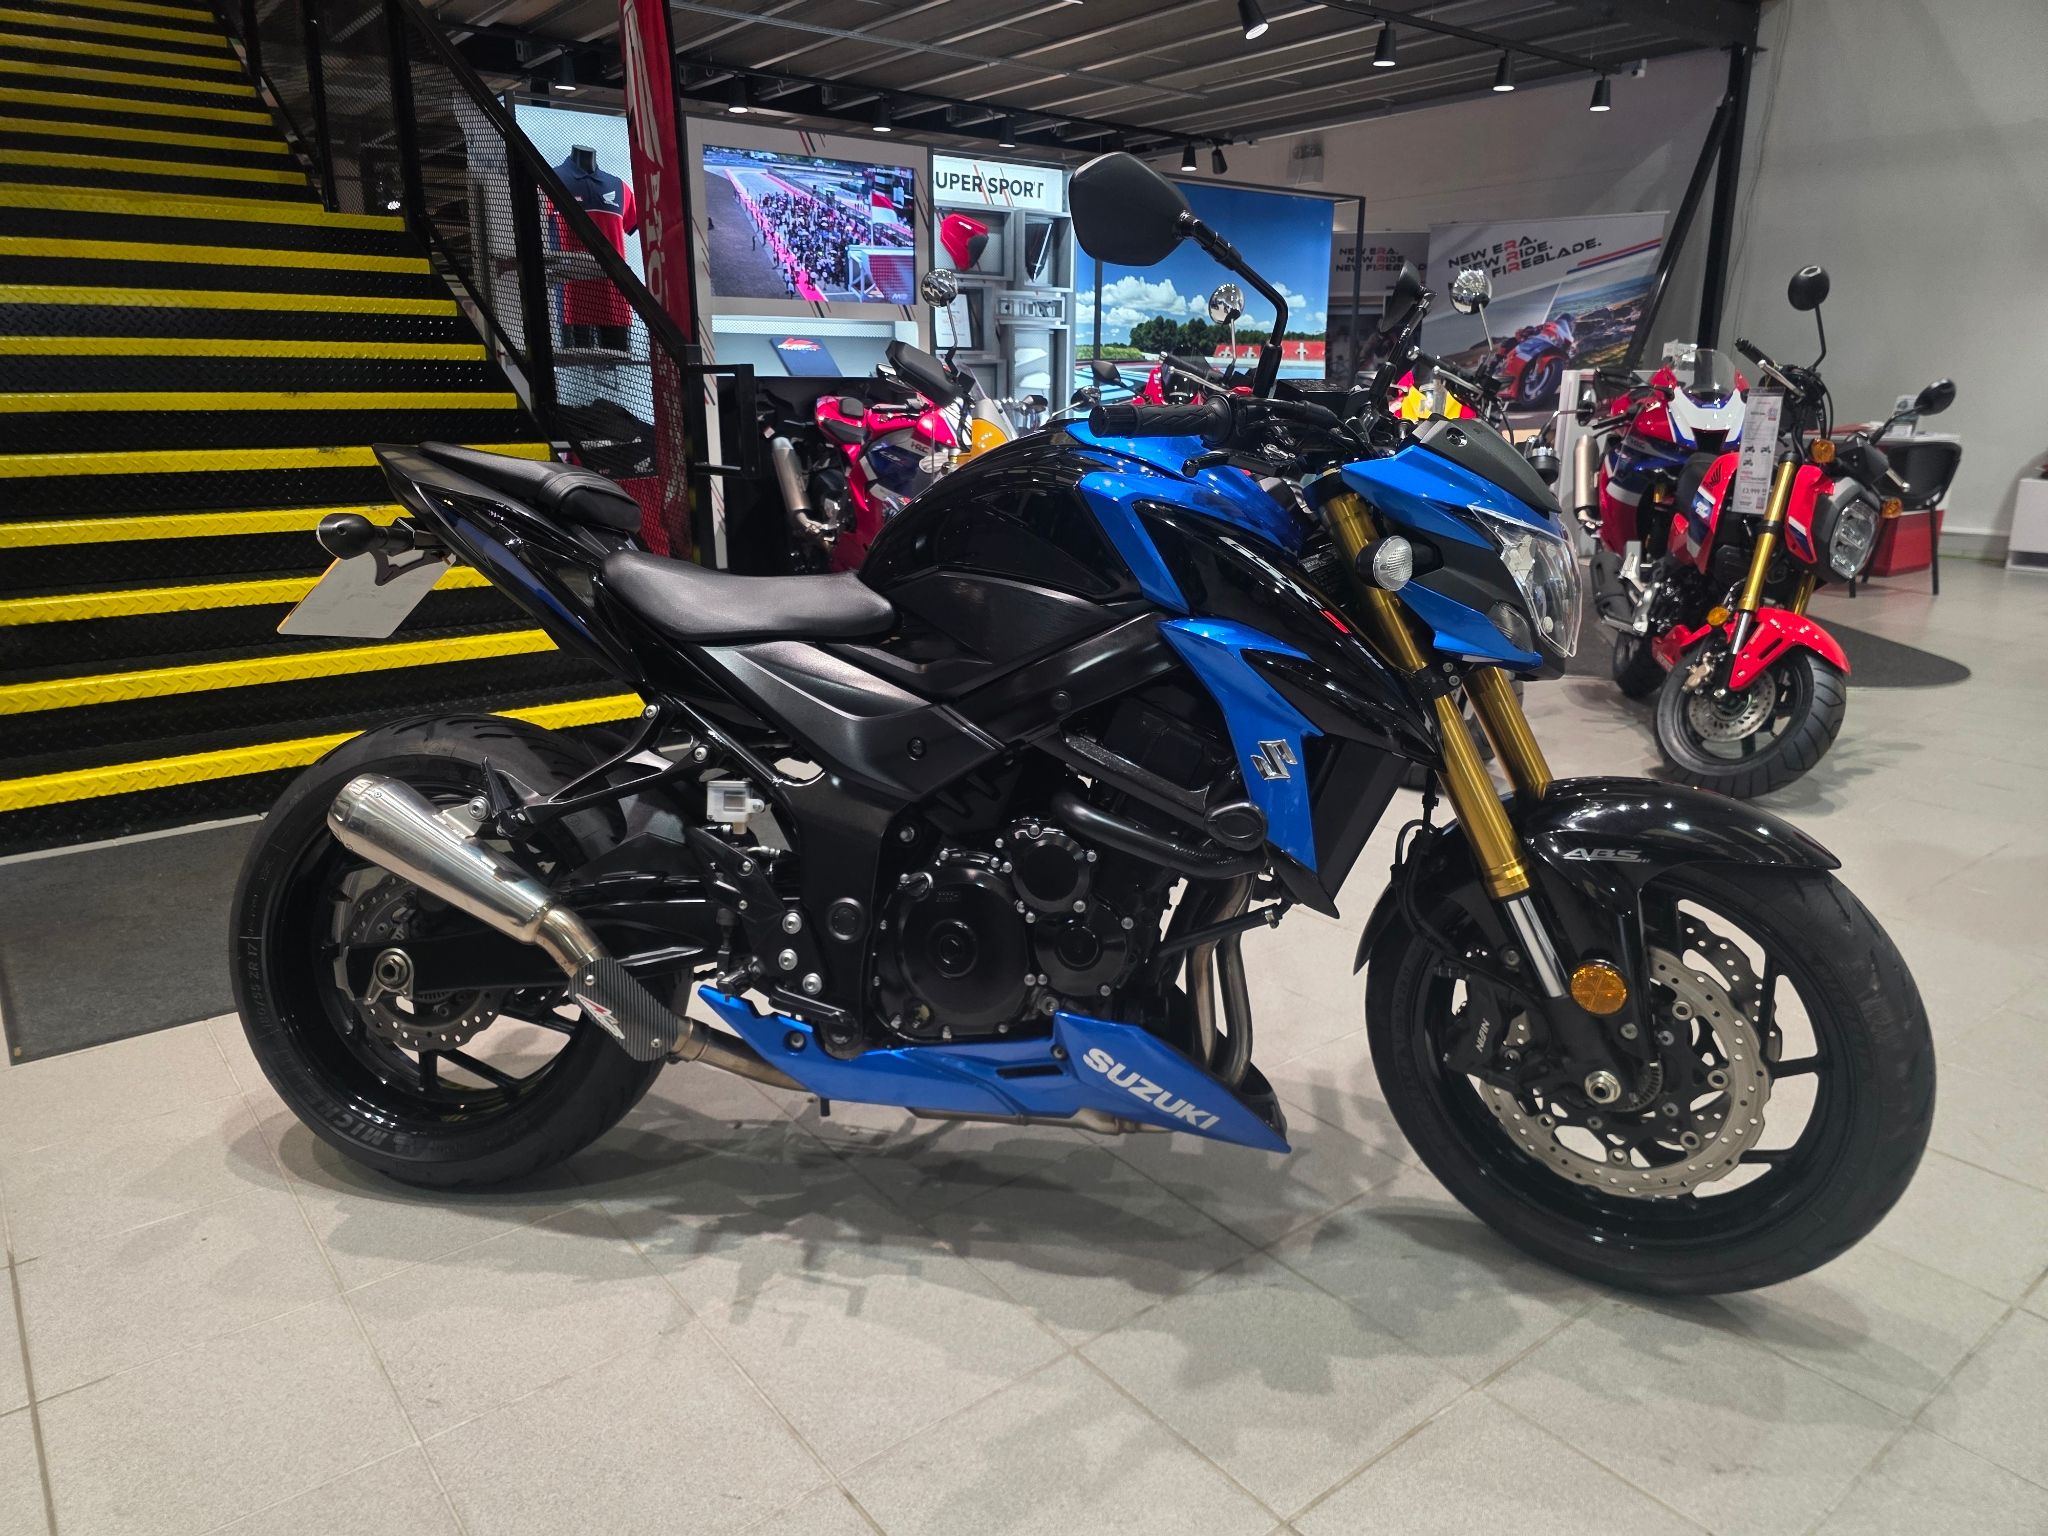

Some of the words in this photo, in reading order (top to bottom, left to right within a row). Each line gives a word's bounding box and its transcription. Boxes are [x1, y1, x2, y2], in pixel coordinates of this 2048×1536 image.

[988, 177, 1044, 199] SPORT
[1347, 255, 1373, 263] NW
[1448, 248, 1487, 268] NEW
[1492, 236, 1537, 254] ERA.
[1491, 238, 1602, 278] FIREBLADE.
[1505, 241, 1553, 263] RIDE.
[1562, 848, 1643, 860] ABS
[1083, 1048, 1220, 1129] SUZUKI
